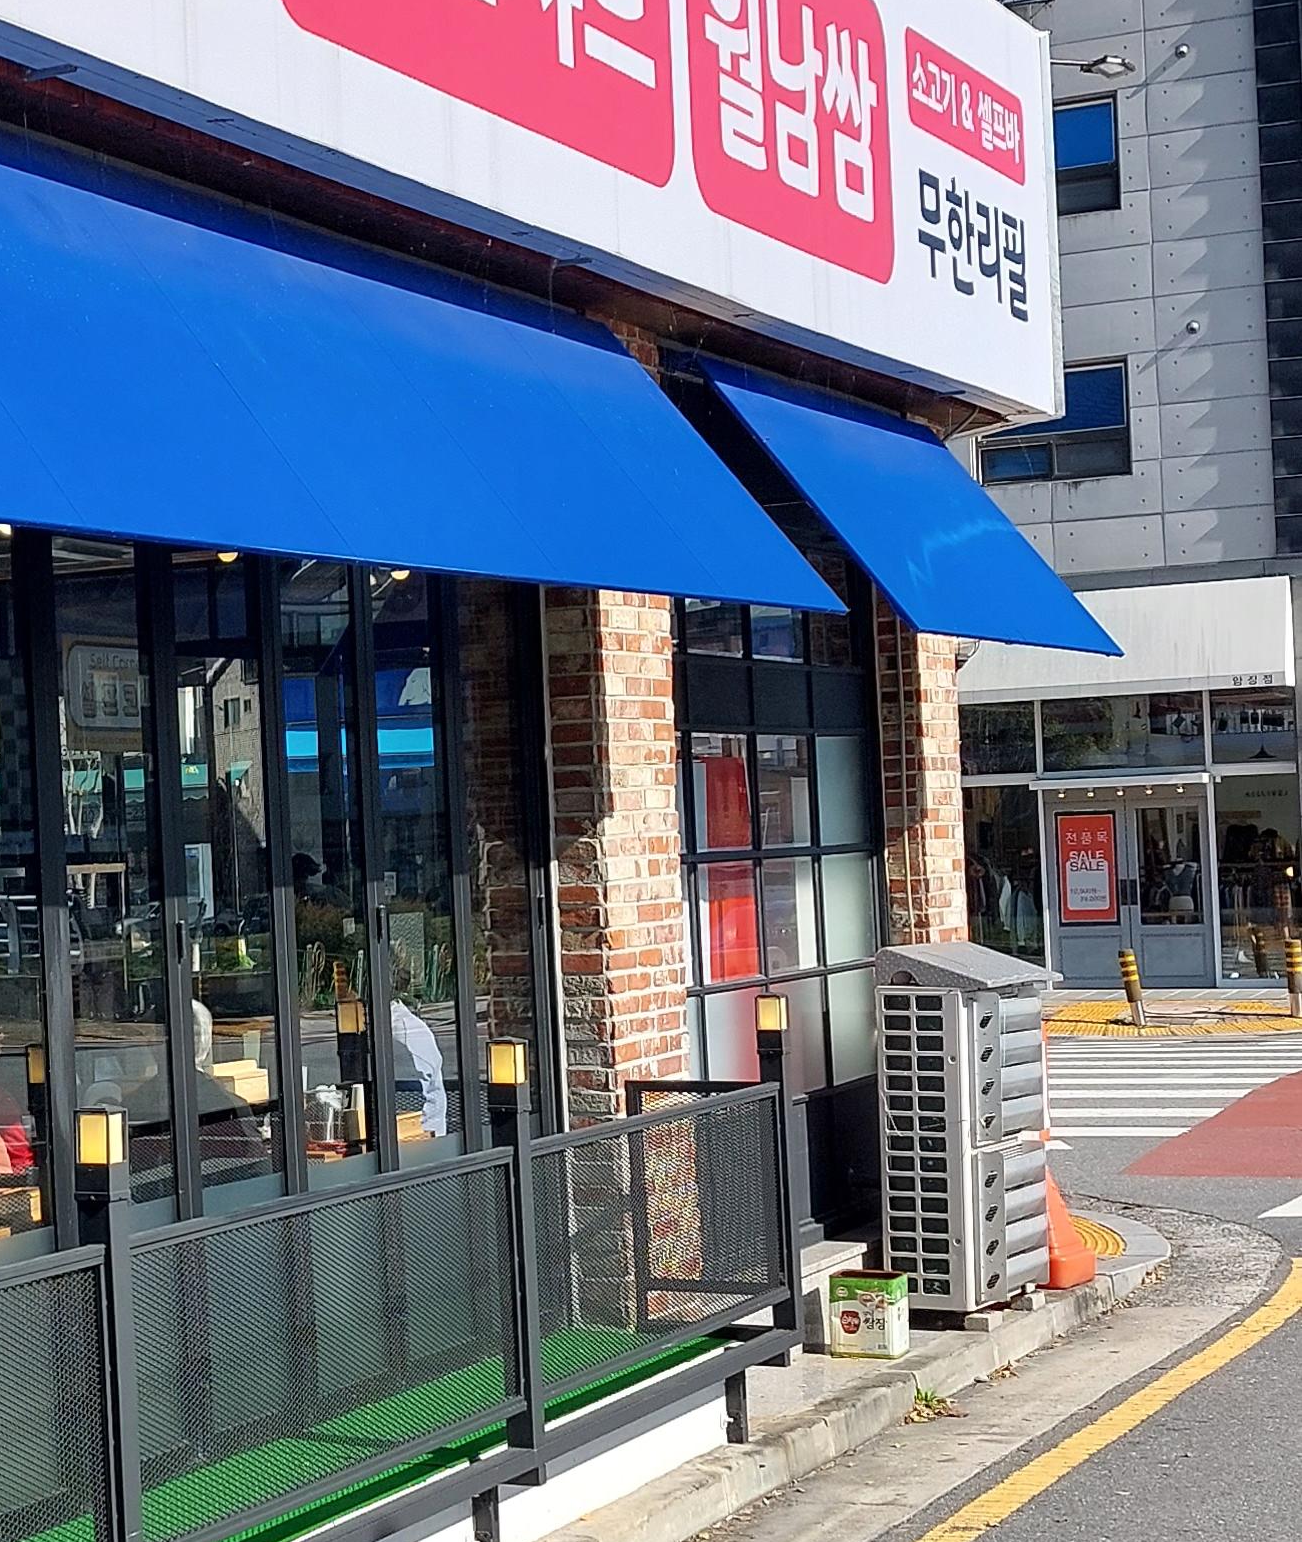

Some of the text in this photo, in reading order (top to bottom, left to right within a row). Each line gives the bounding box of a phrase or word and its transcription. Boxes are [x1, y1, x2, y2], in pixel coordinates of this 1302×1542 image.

[911, 50, 1021, 165] 소고기 & 셀프바
[918, 167, 1029, 323] 무한리필
[1069, 849, 1105, 862] SALE
[1069, 861, 1105, 872] SALE
